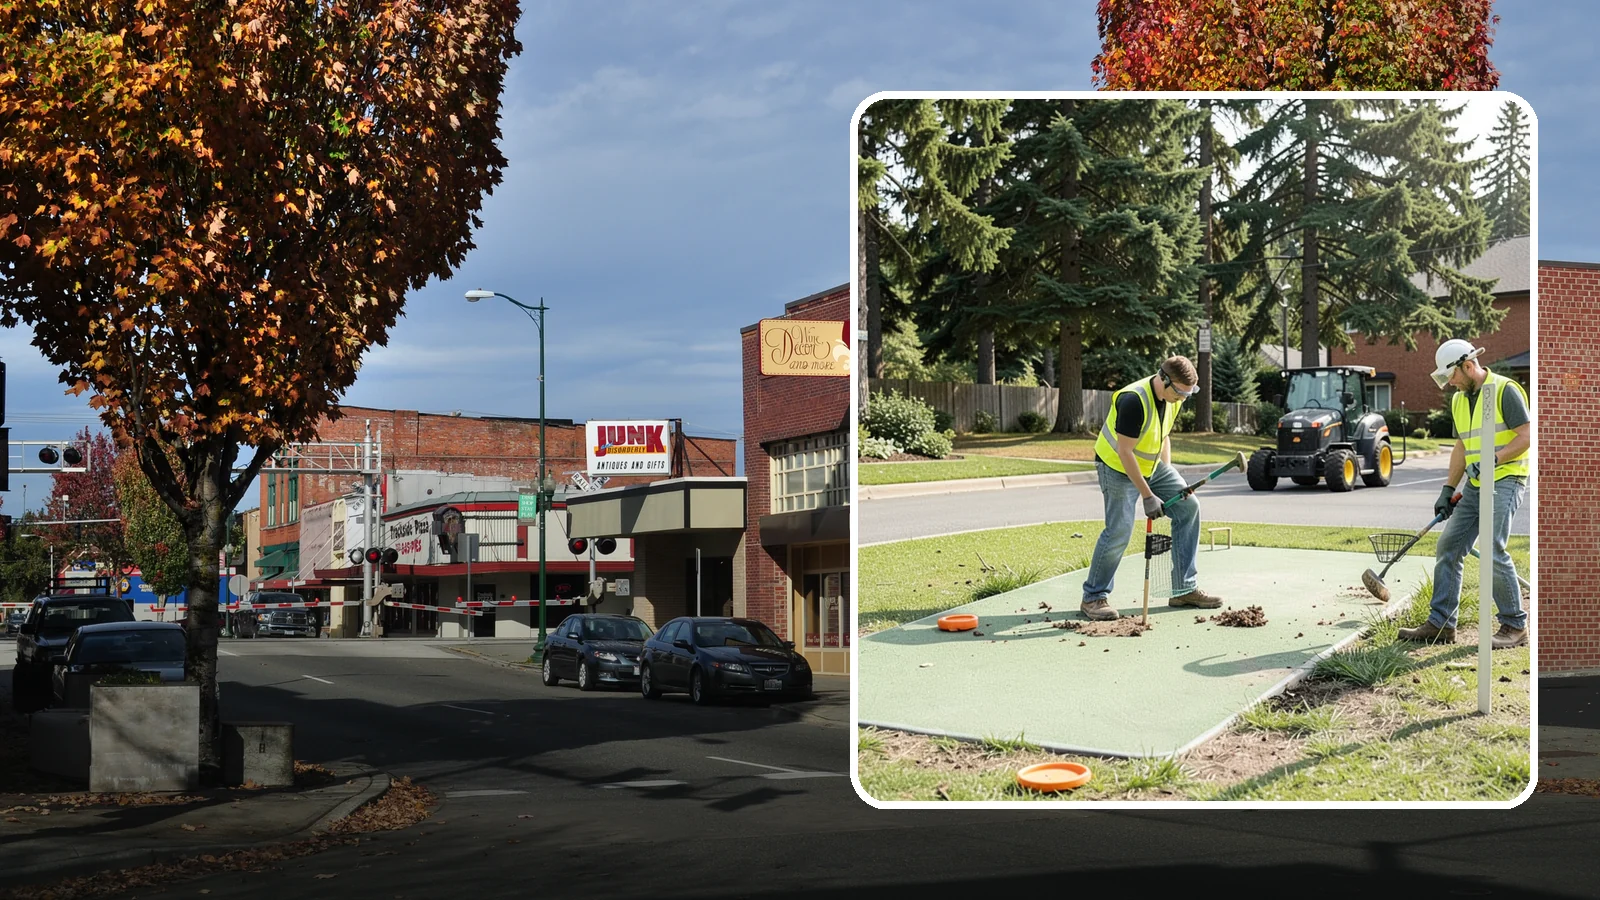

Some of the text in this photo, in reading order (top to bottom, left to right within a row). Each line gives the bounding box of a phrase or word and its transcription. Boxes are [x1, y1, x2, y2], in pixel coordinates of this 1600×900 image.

[765, 327, 830, 365] Decor
[595, 425, 665, 457] JUNK
[607, 446, 646, 454] DISORDERLY
[596, 460, 666, 470] ANTIQUES AND GIFTS
[414, 519, 429, 535] Pizza
